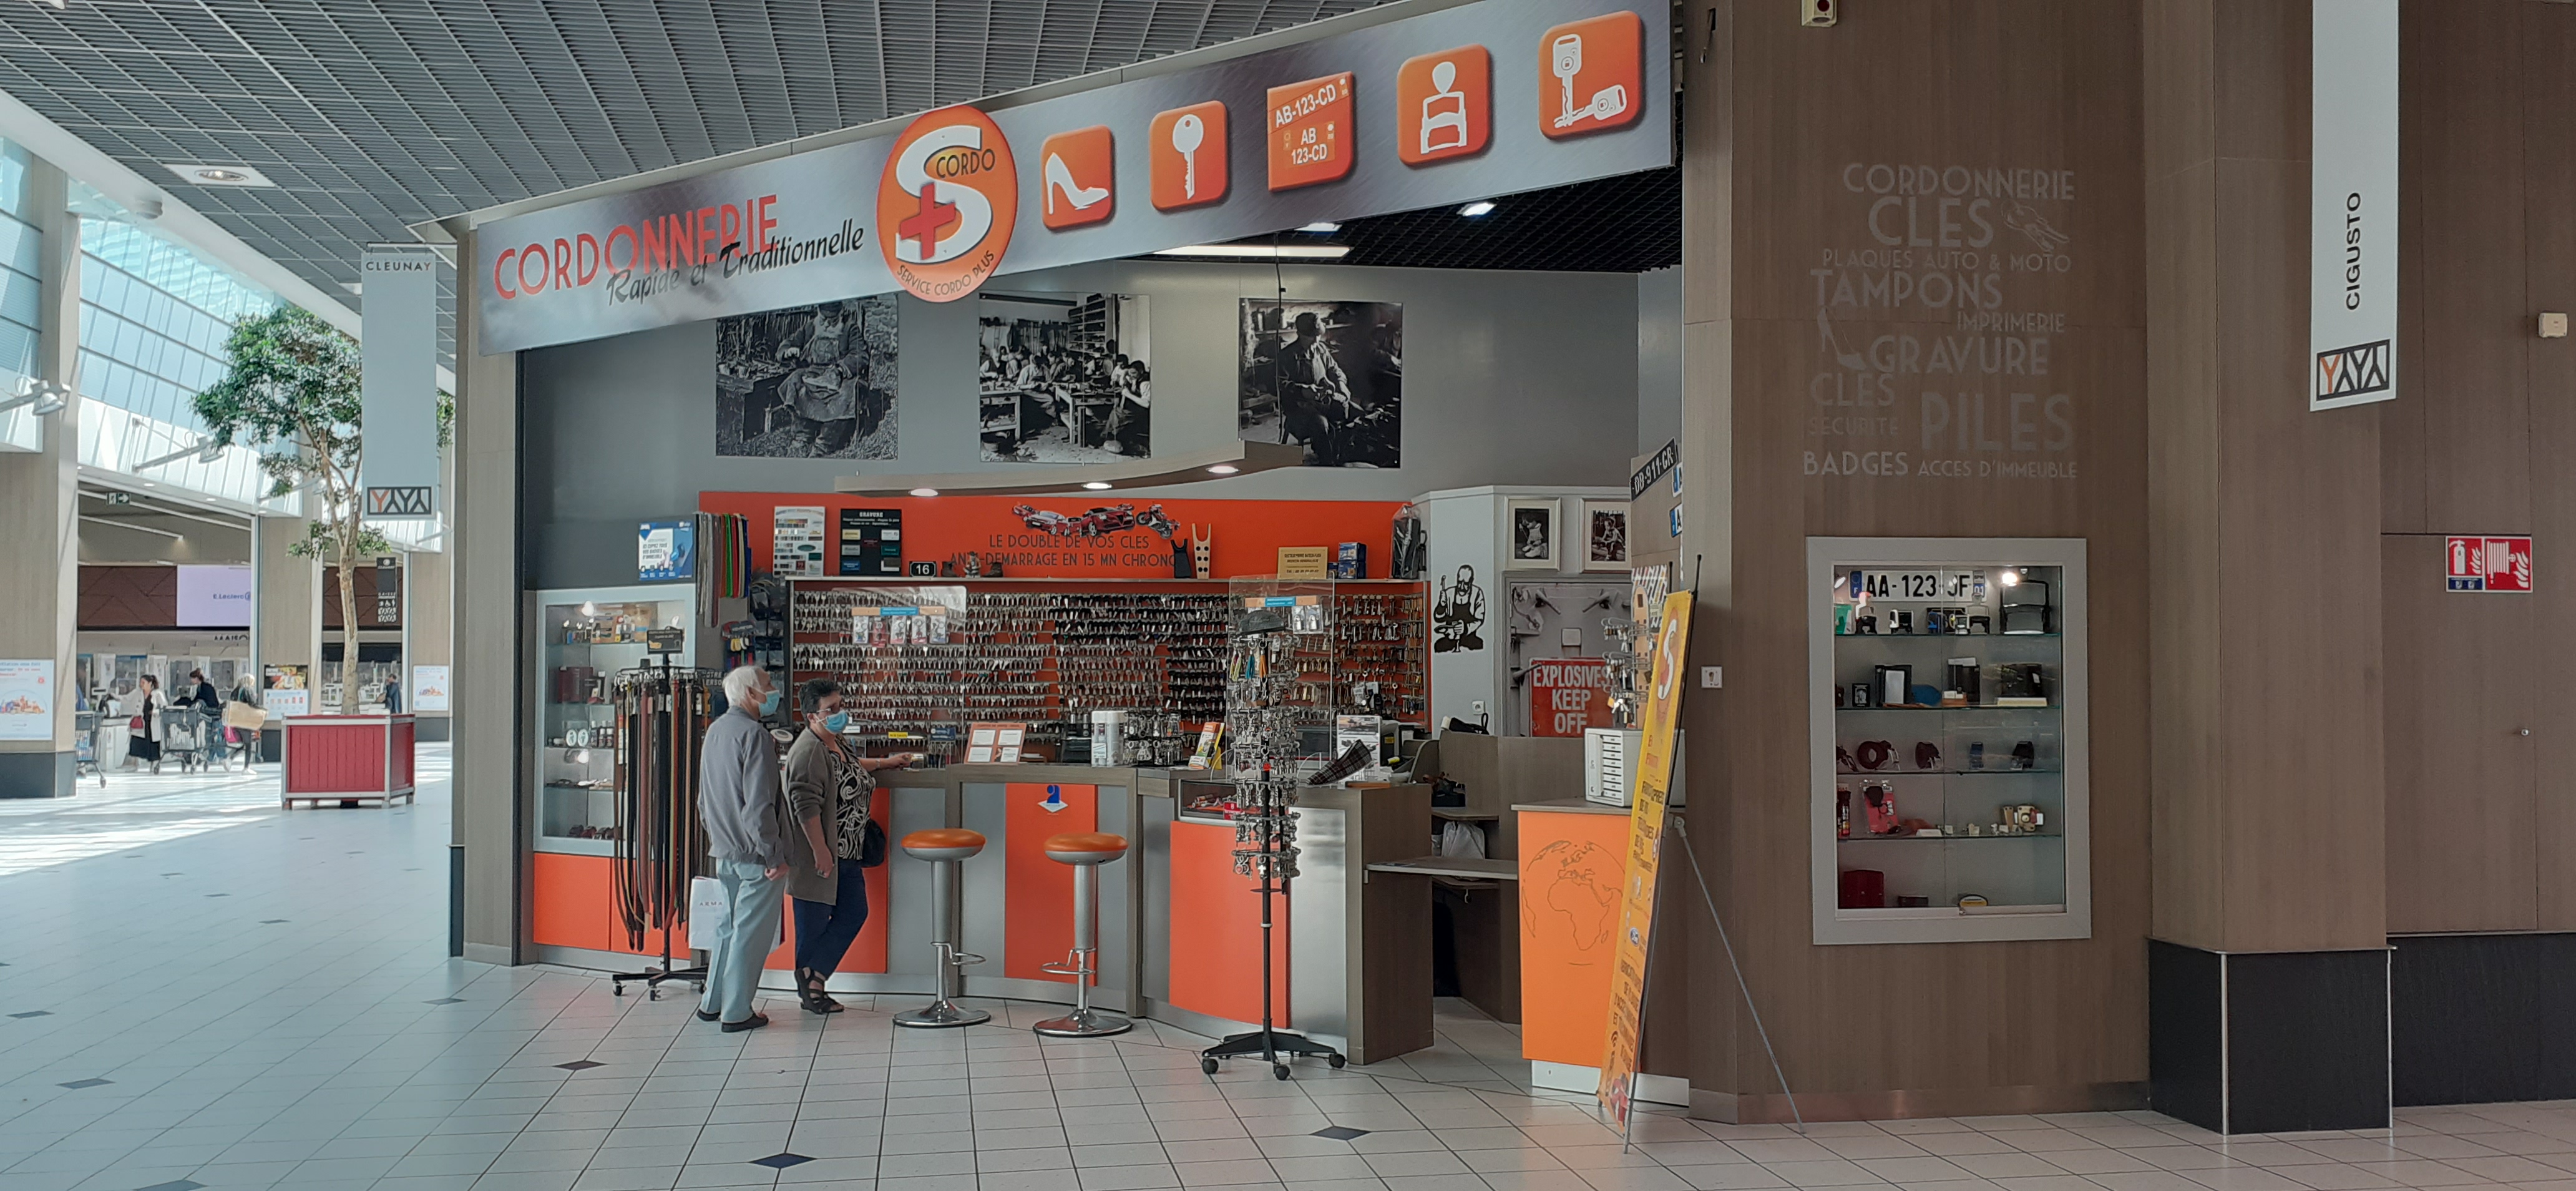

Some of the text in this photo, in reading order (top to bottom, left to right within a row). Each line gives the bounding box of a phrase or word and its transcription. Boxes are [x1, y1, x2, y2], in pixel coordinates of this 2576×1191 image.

[1275, 84, 1337, 128] AB-123-CD
[1300, 127, 1317, 145] AB
[935, 148, 996, 179] CORDO
[1291, 143, 1328, 165] 123-CD
[1842, 162, 2075, 200] CORDONNERIE
[1868, 195, 1994, 248] CLES
[492, 194, 778, 300] CORDONNERIE
[1822, 248, 2072, 273] PLAQUES AUTO & MOTO
[2346, 192, 2361, 311] CIGUSTO
[365, 261, 431, 272] CLEUNAY
[606, 217, 864, 306] Rapide et Traditionnelle
[897, 250, 995, 296] SERVICE CORDO PLUS
[1810, 269, 2003, 309] TAMPONS
[1957, 311, 2066, 333] IMPRIMERIE
[1869, 335, 2049, 375] GRAVURE
[1810, 373, 1895, 407] CLES
[1808, 416, 1899, 436] SECURITE
[1920, 391, 2075, 452] PILES
[1803, 451, 2078, 479] BADGES ACCES D'IMMEUBLE
[989, 534, 1150, 549] LE DOUBLE DE VOS CLES
[915, 564, 930, 575] 16
[1063, 553, 1078, 566] EN
[1083, 553, 1094, 566] 15
[1100, 553, 1117, 567] MN
[1533, 665, 1610, 688] EXPLOSIVES
[1551, 689, 1591, 711] KEEP
[1554, 713, 1588, 734] OFF
